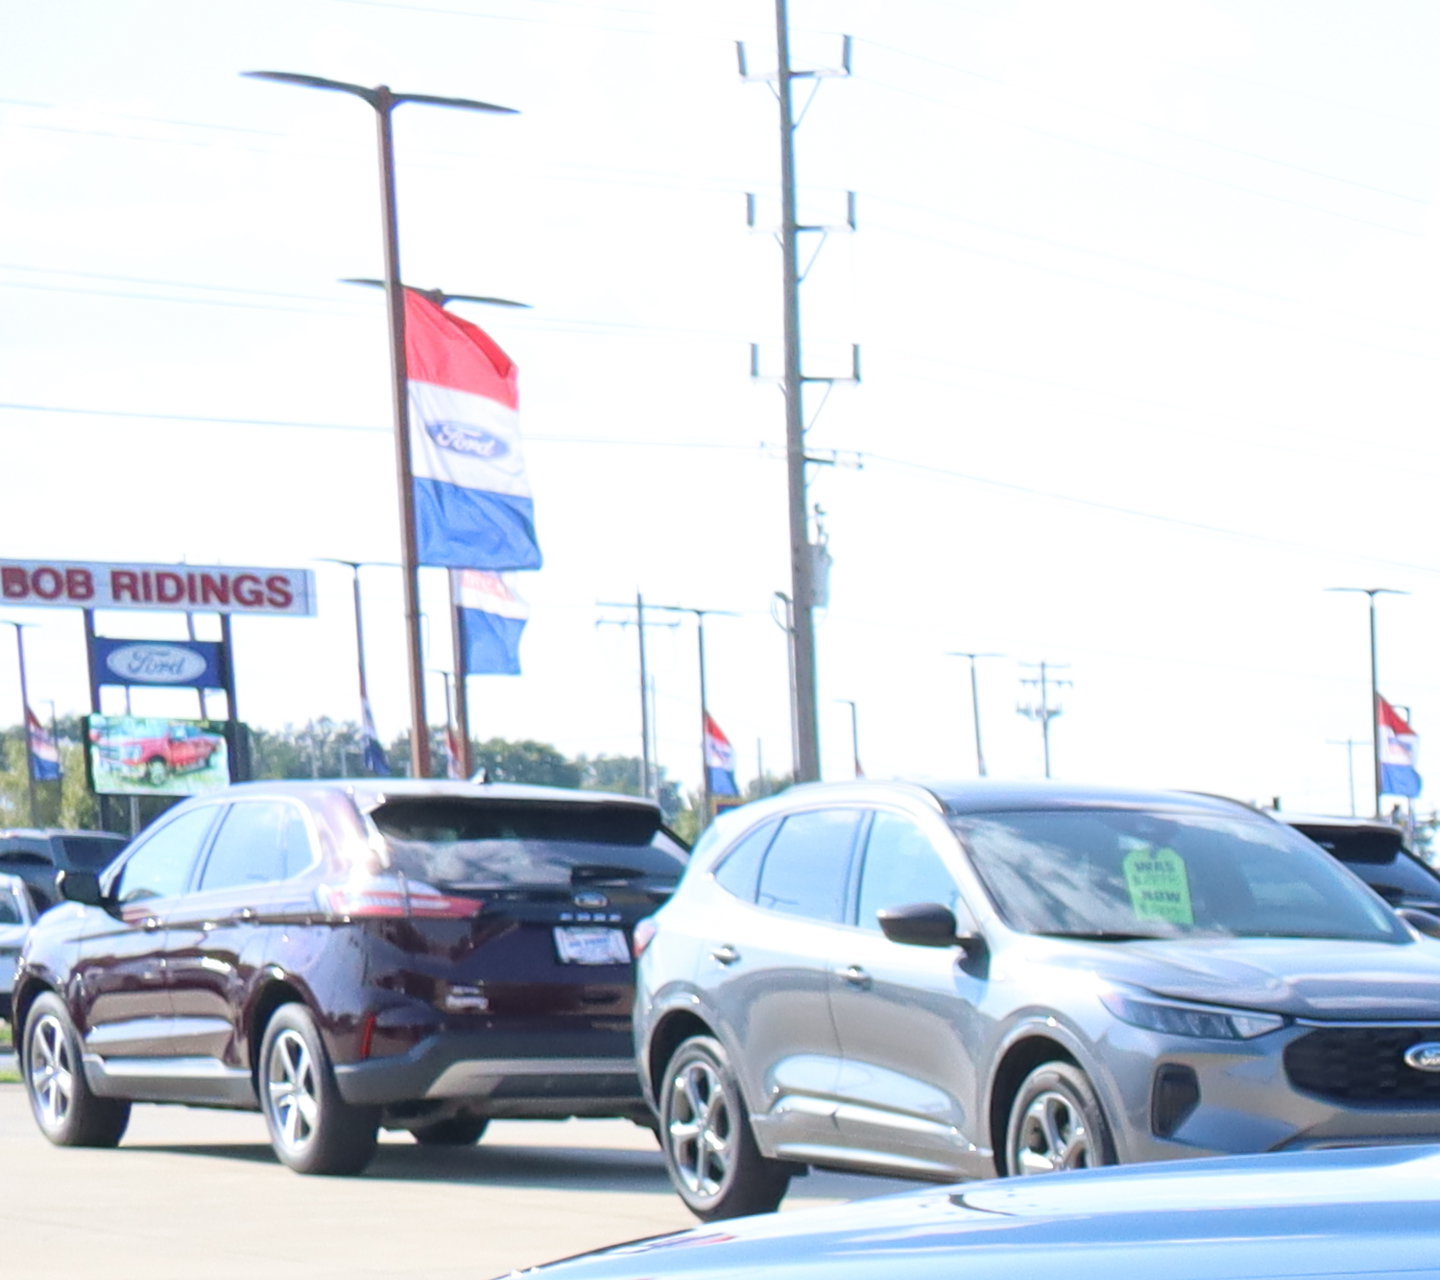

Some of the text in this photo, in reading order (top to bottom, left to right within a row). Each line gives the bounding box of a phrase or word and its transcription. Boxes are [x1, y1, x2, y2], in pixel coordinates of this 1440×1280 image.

[436, 423, 495, 458] Ford
[1, 566, 293, 609] BOB RIDINGS
[128, 649, 186, 675] Ford
